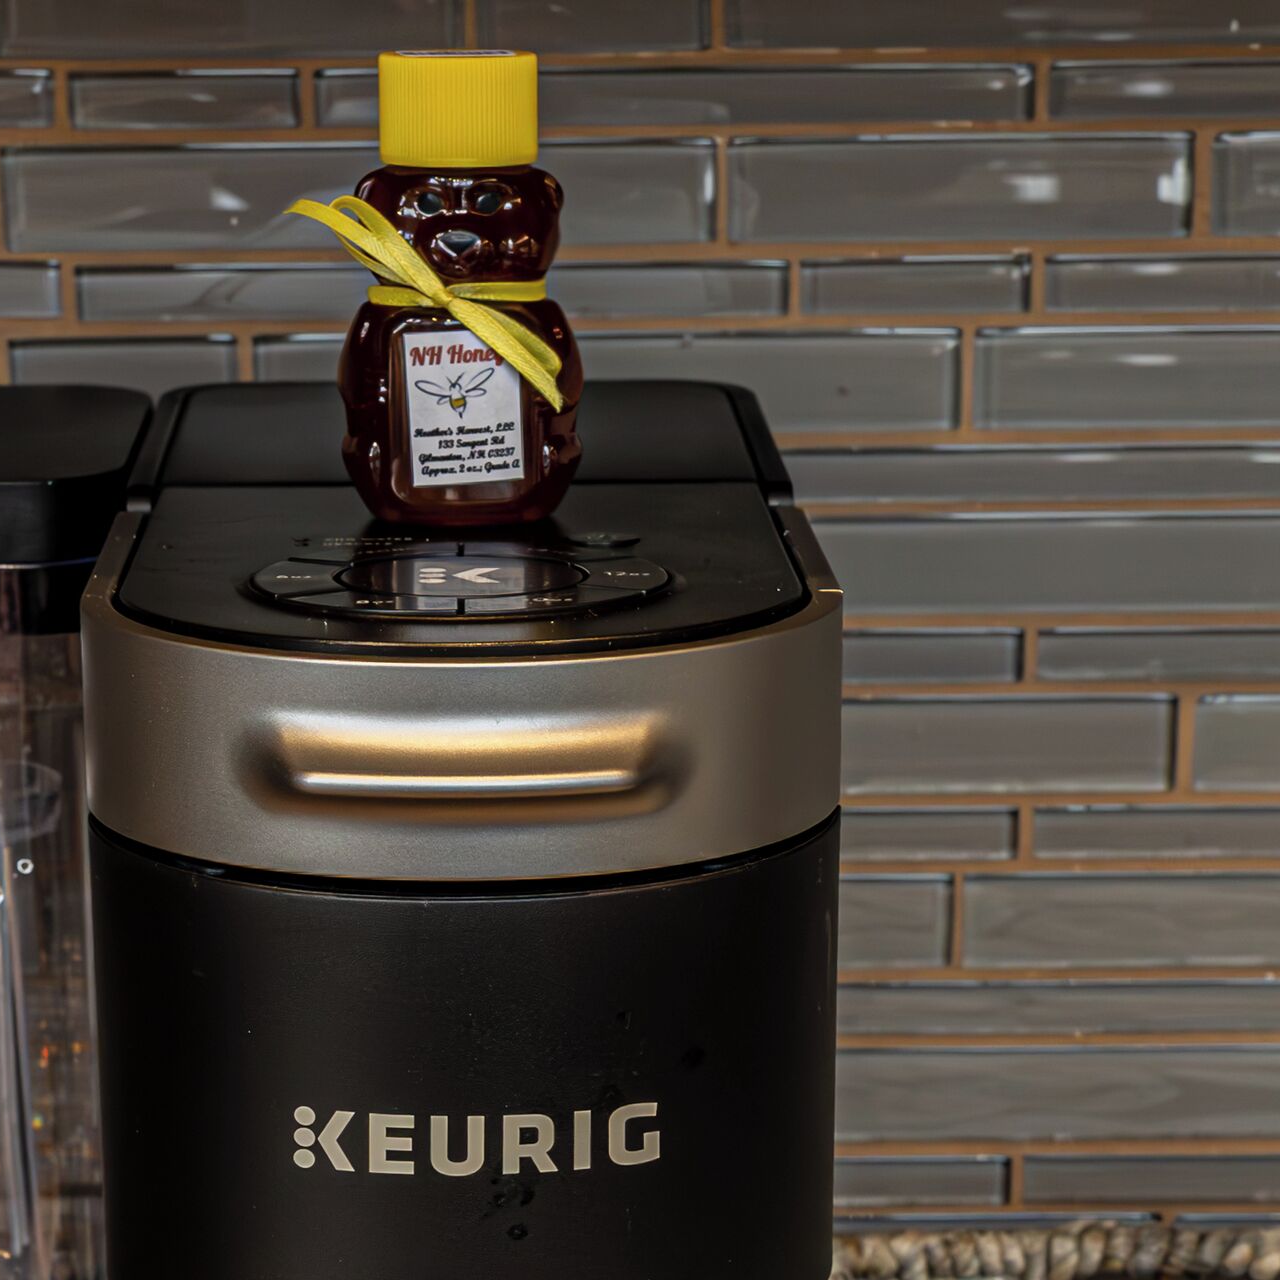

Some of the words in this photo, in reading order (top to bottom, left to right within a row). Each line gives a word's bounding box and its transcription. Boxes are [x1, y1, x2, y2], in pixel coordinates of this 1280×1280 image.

[410, 345, 443, 366] NH
[414, 427, 453, 437] Heather's
[438, 440, 454, 449] 133
[490, 436, 505, 445] Rd
[467, 449, 485, 460] NH
[421, 466, 457, 477] Approx.
[459, 464, 465, 473] 2
[484, 461, 510, 473] Grade
[512, 459, 520, 468] A
[293, 1102, 660, 1177] KEURIG
